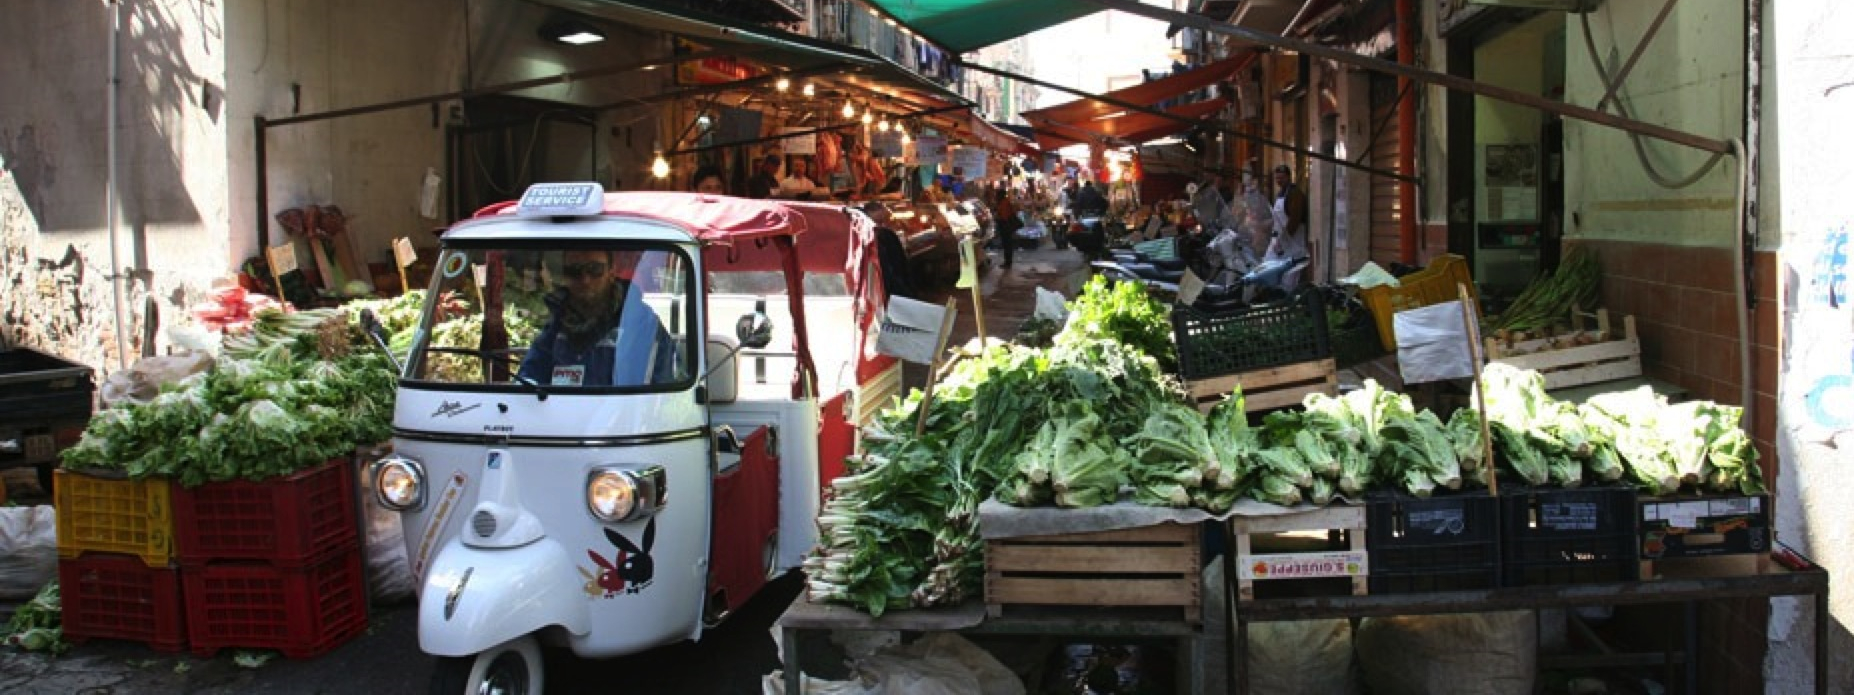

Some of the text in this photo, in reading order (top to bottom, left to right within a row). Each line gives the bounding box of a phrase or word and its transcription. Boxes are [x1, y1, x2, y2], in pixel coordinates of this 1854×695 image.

[529, 186, 591, 197] TOURIST
[525, 196, 584, 206] SERVICE
[1271, 562, 1333, 575] GIUSEPPE
